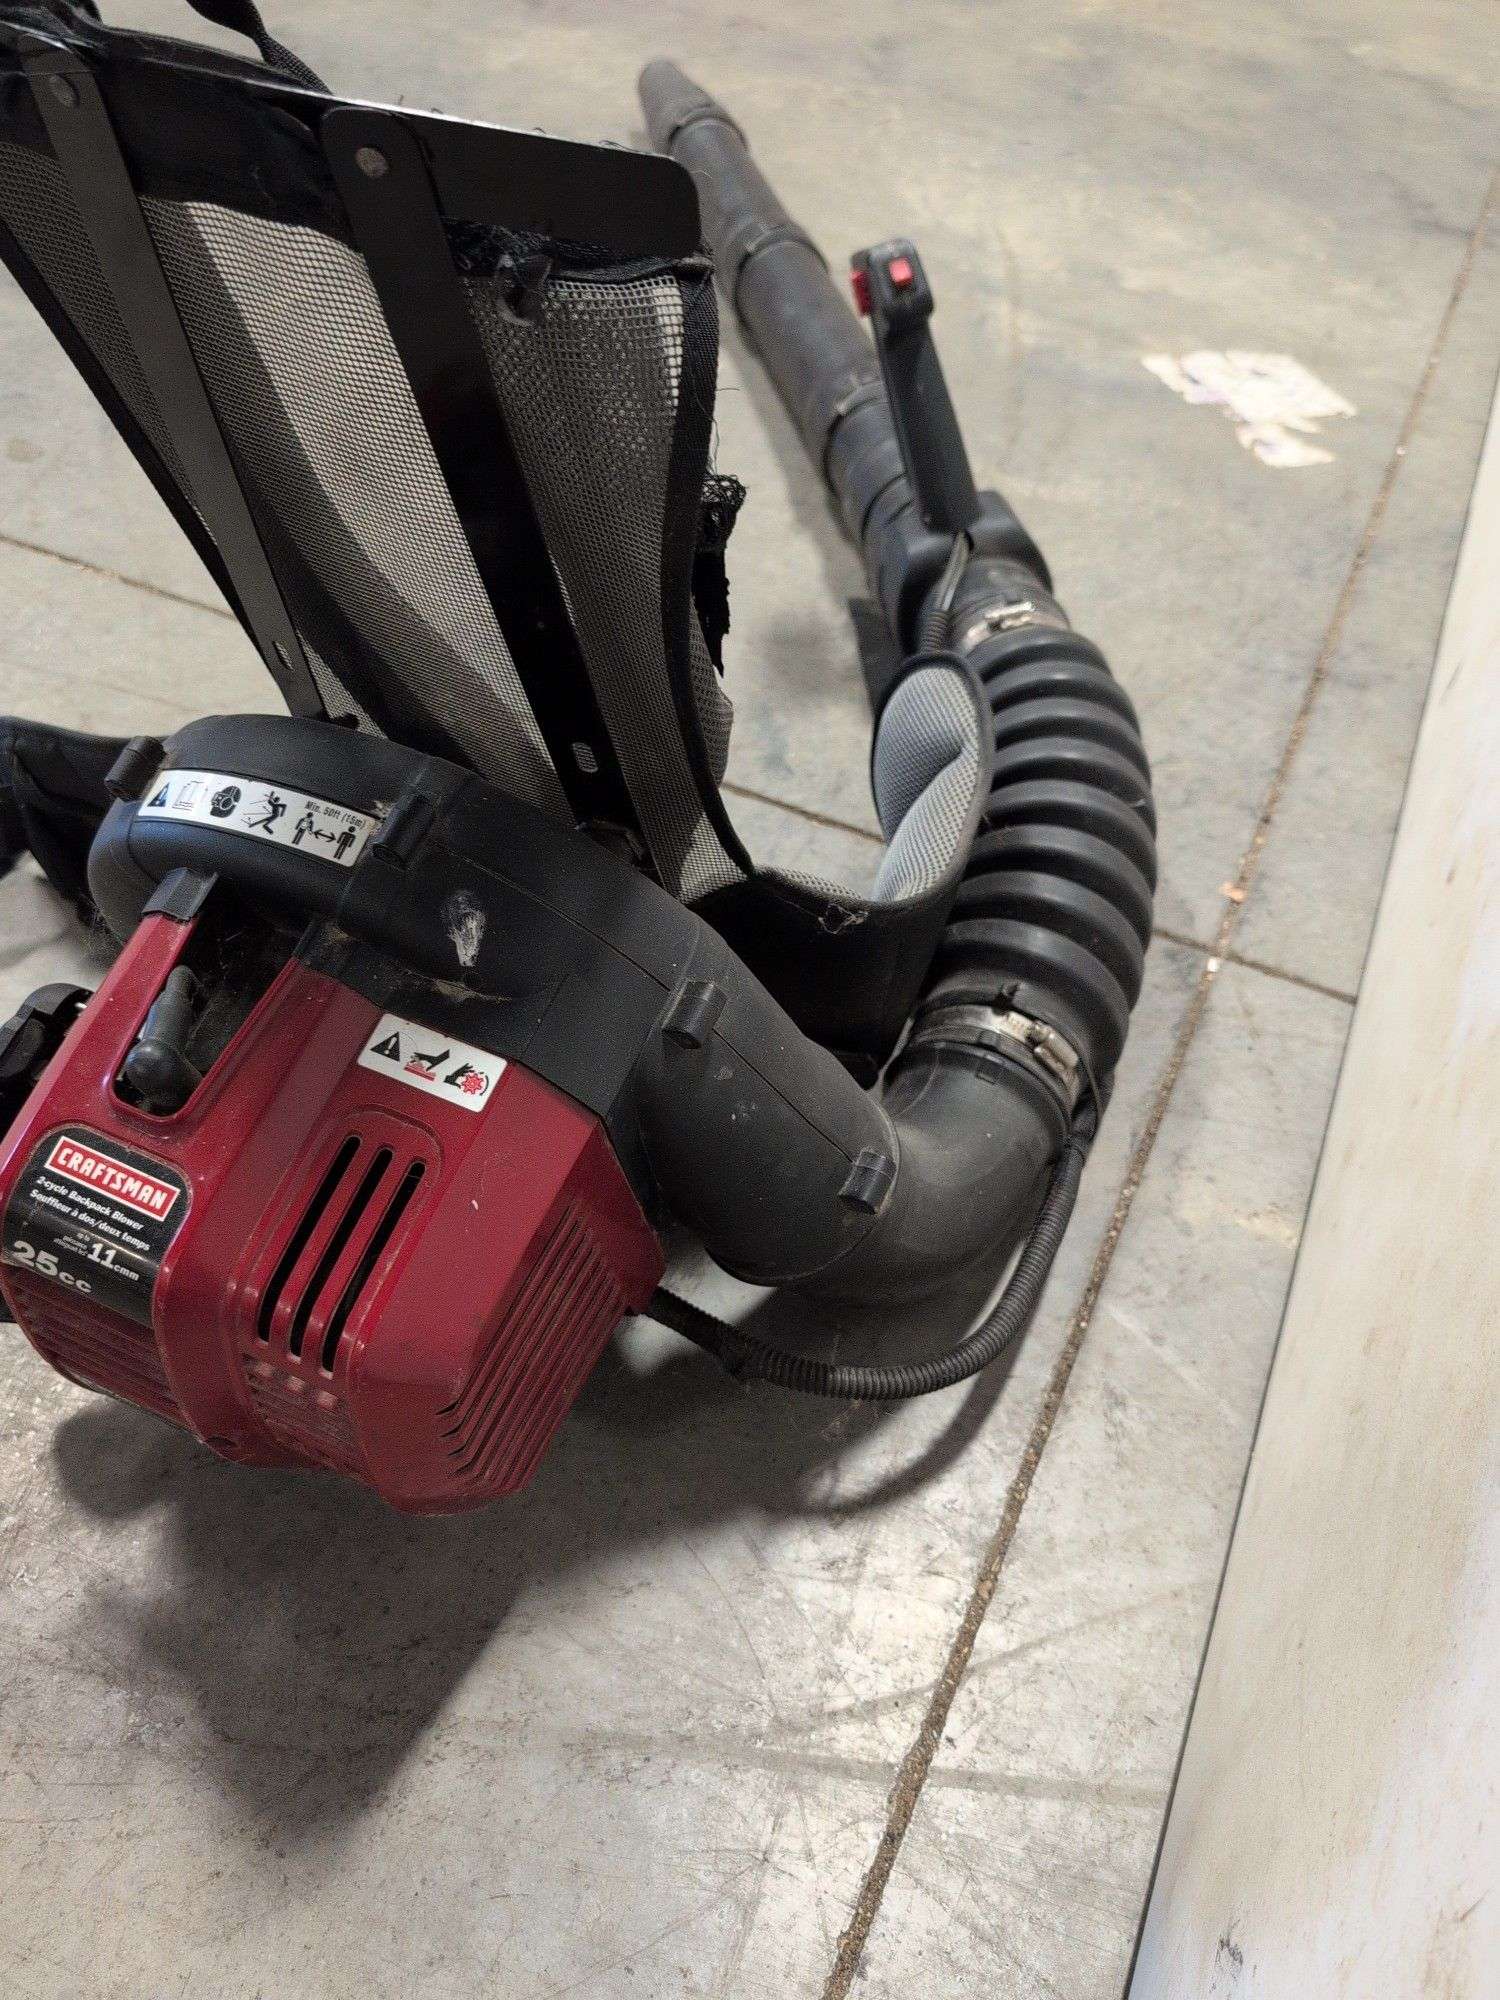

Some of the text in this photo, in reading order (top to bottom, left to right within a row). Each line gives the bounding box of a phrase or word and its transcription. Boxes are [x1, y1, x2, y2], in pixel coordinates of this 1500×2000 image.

[36, 1175, 144, 1231] 2-cycle Backpack Blower
[56, 1147, 168, 1210] CRAFTSMAN
[30, 1188, 73, 1214] Souffleur
[121, 1232, 151, 1252] temps
[11, 1240, 92, 1294] 25cc
